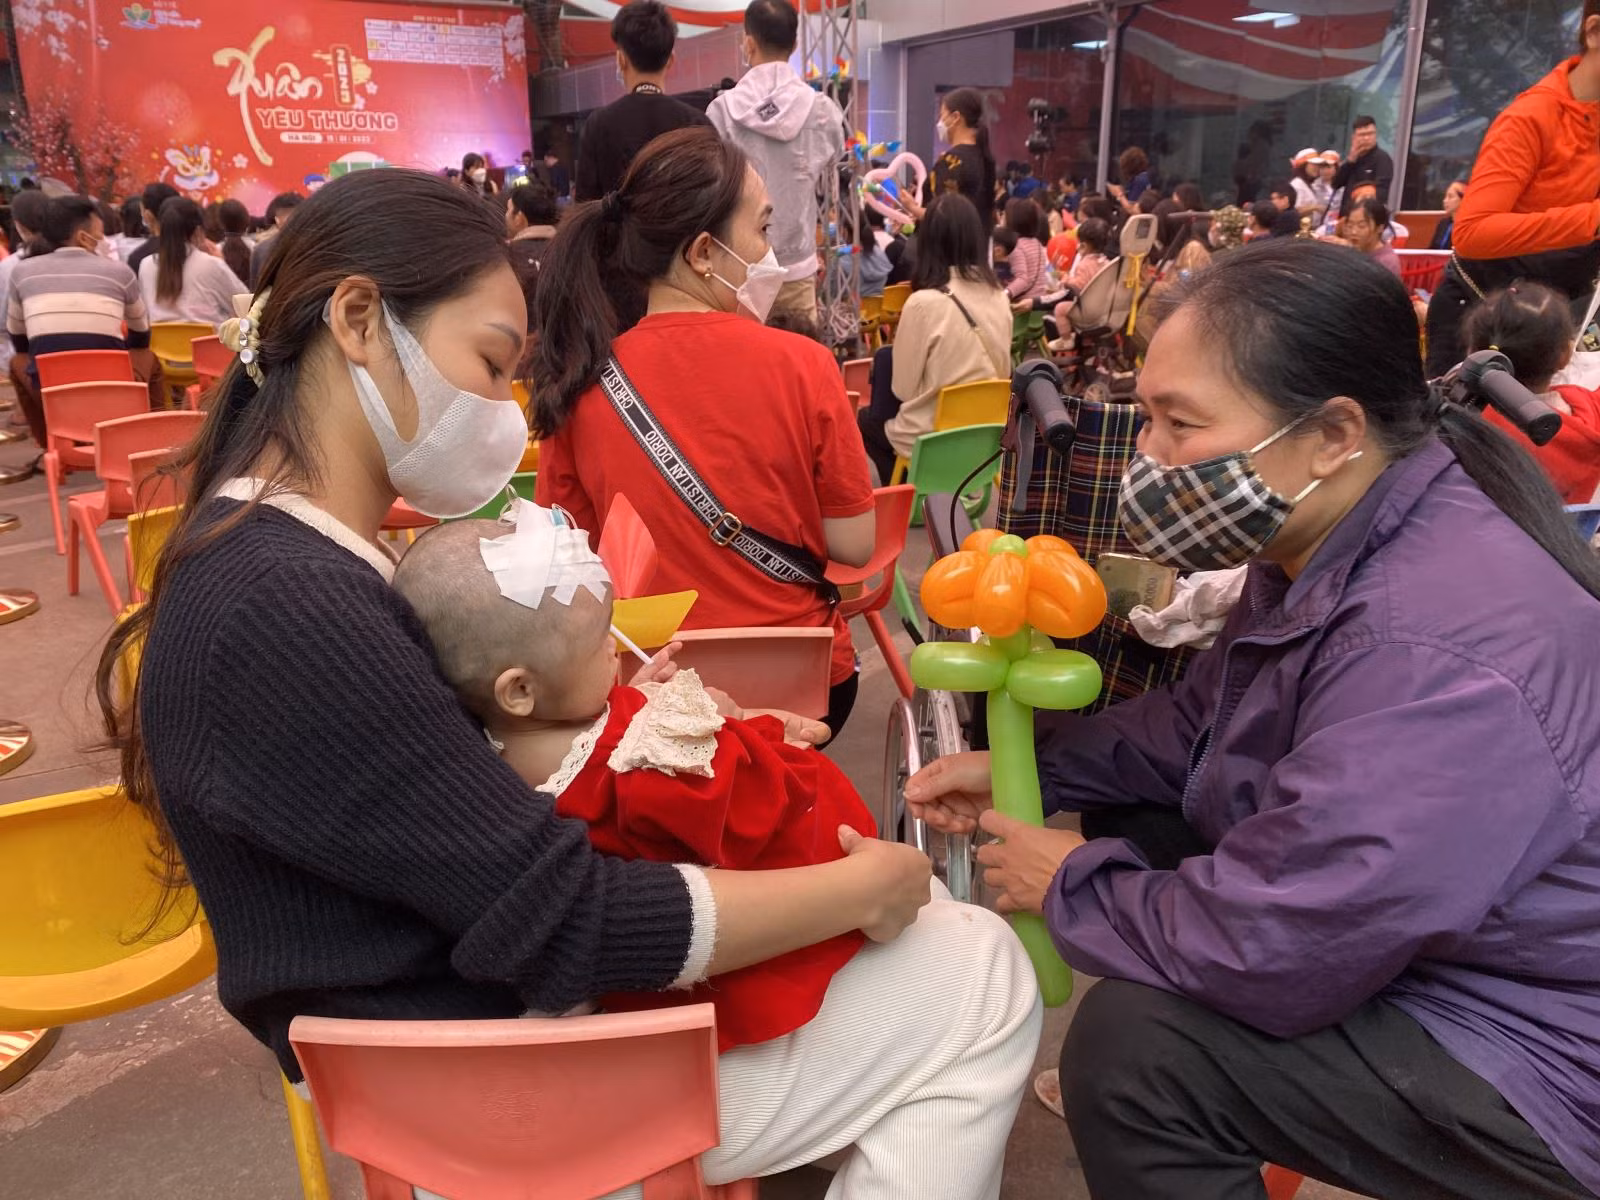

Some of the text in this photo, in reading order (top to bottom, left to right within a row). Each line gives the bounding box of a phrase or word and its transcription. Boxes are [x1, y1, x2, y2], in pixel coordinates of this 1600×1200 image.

[256, 106, 399, 132] YÊU THƯƠNG
[645, 429, 718, 520] CHRISTIAN DORIO
[734, 535, 767, 561] DORIO
